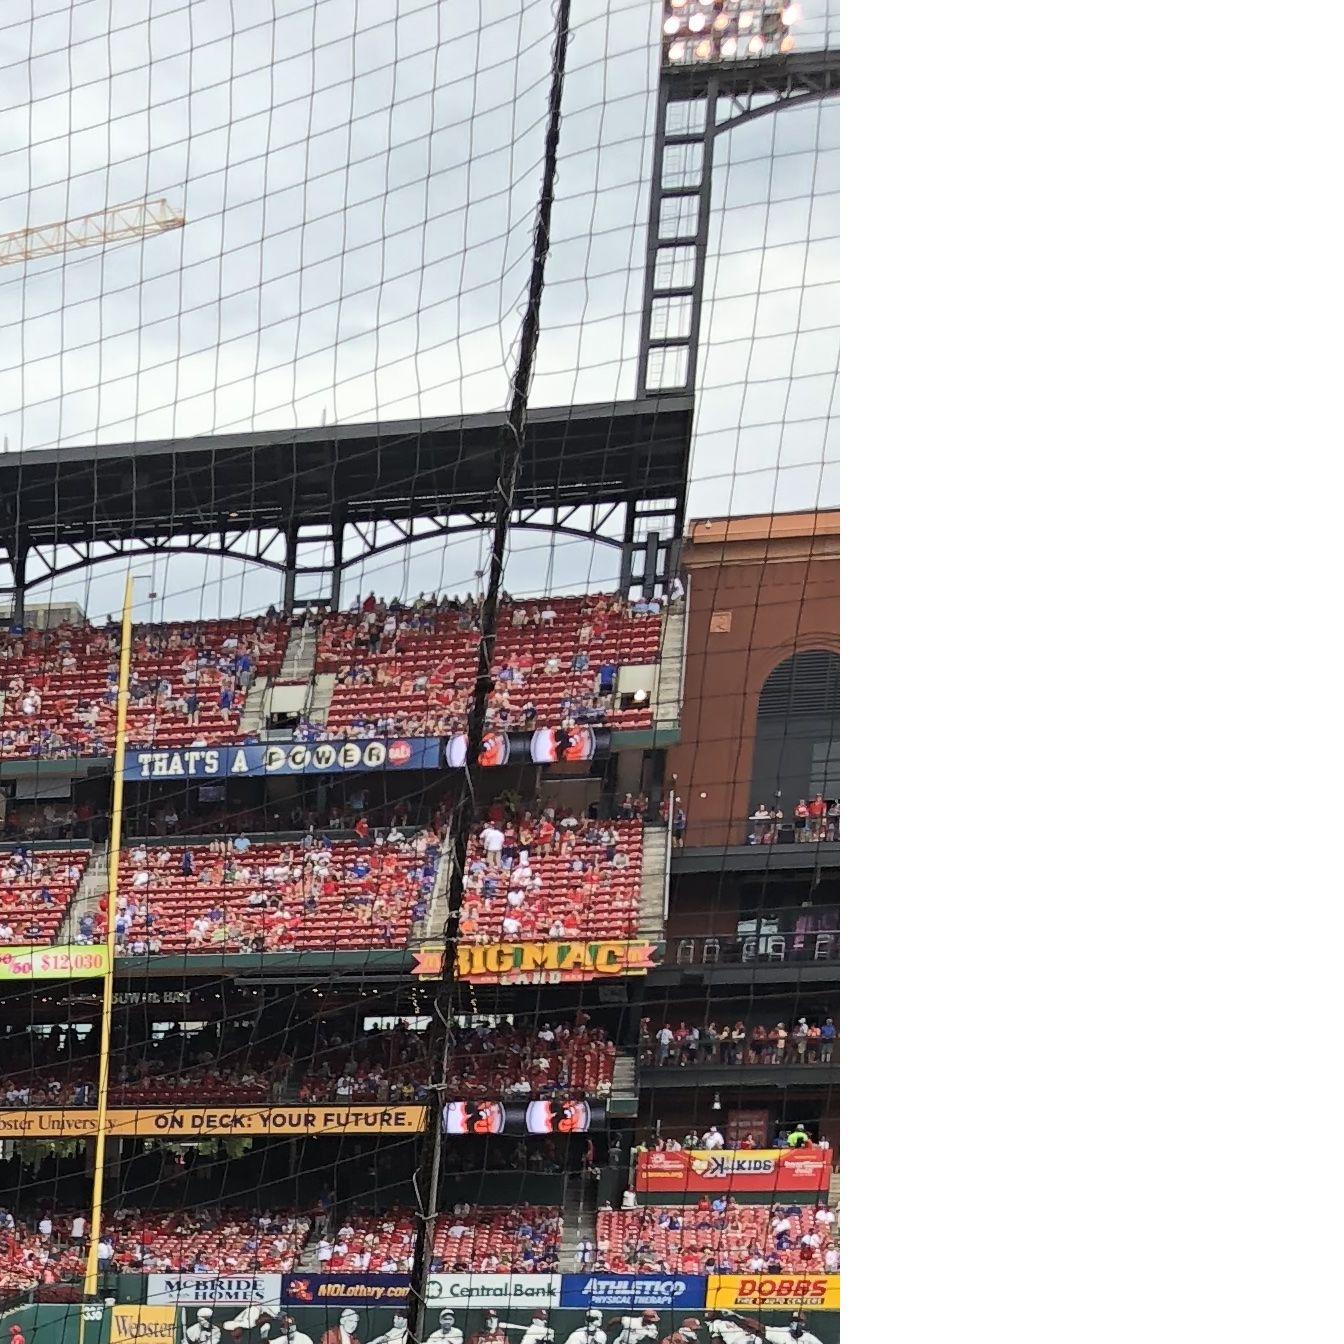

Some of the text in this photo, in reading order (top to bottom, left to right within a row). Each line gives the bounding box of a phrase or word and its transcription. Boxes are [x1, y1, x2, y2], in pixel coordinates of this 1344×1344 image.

[138, 750, 219, 777] THAT'S
[231, 750, 249, 773] A
[41, 953, 103, 971] $12,030
[521, 940, 629, 973] MAC
[38, 1113, 116, 1133] Universy
[154, 1114, 184, 1129] ON
[190, 1113, 252, 1128] DECK:
[259, 1113, 316, 1128] YOUR
[323, 1111, 413, 1127] FUTURE.
[194, 1291, 265, 1300] HOMES
[318, 1284, 410, 1299] MOLottery.com
[450, 1283, 557, 1297] Central Bank
[582, 1278, 686, 1296] ATHLETICO
[738, 1280, 827, 1296] DOBBS
[115, 1315, 176, 1338] Webster
